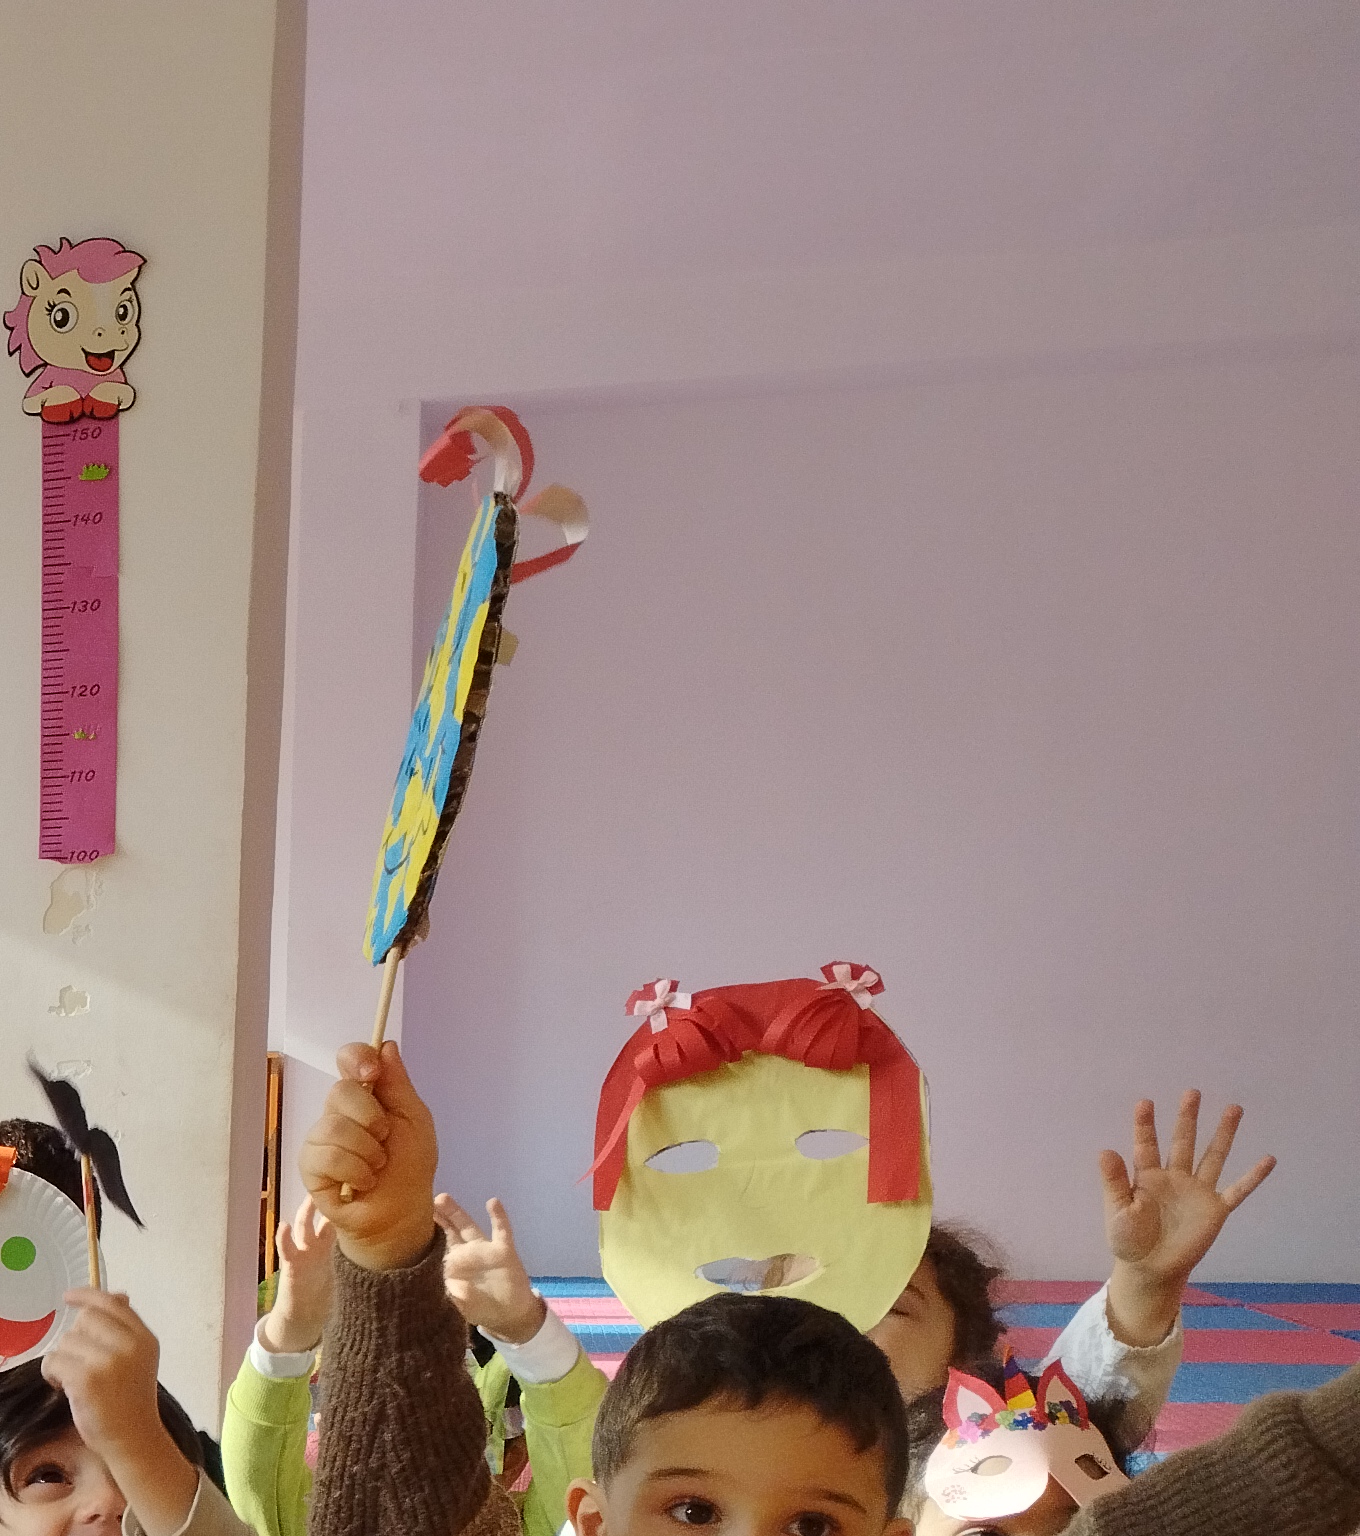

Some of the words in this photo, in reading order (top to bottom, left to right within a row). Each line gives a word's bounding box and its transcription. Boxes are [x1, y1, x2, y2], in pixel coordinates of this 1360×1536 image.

[72, 426, 102, 441] 150
[72, 511, 103, 526] 140
[70, 599, 101, 614] 130
[70, 683, 101, 698] 120
[69, 768, 96, 783] 110
[69, 849, 100, 862] 100
